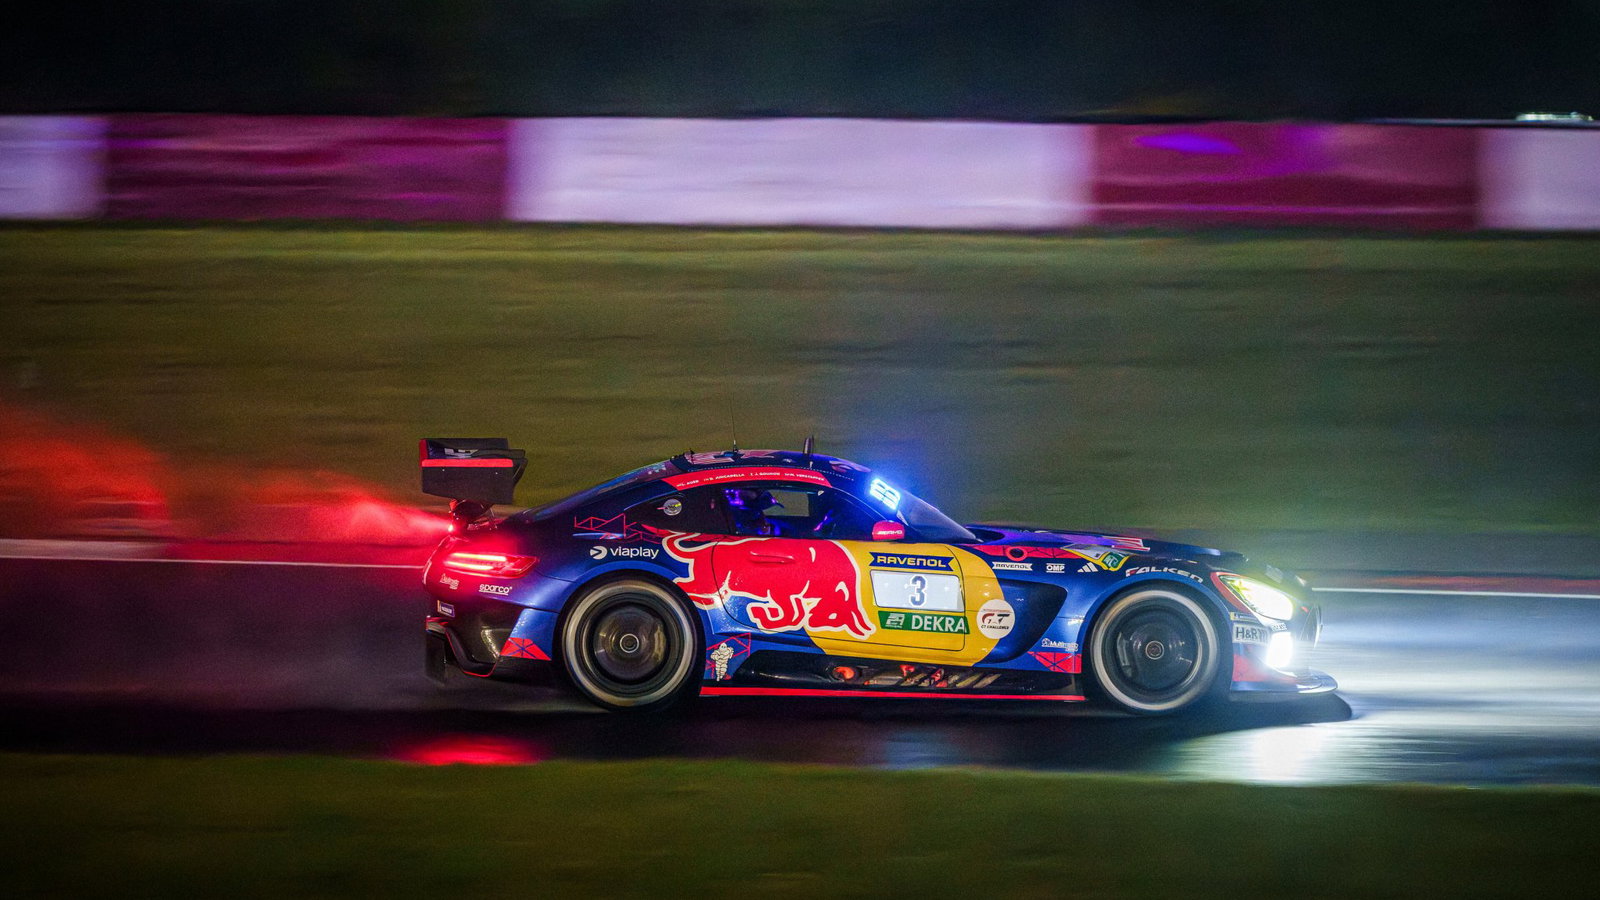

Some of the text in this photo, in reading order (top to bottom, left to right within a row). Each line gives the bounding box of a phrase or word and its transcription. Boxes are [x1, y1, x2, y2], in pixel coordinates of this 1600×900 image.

[610, 546, 659, 560] viaplay
[876, 555, 947, 568] RAVENOL
[1125, 566, 1204, 584] FALKEN
[479, 583, 510, 595] sparco
[909, 574, 927, 607] 3
[911, 614, 967, 633] DEKRA
[1236, 626, 1258, 639] H&R
